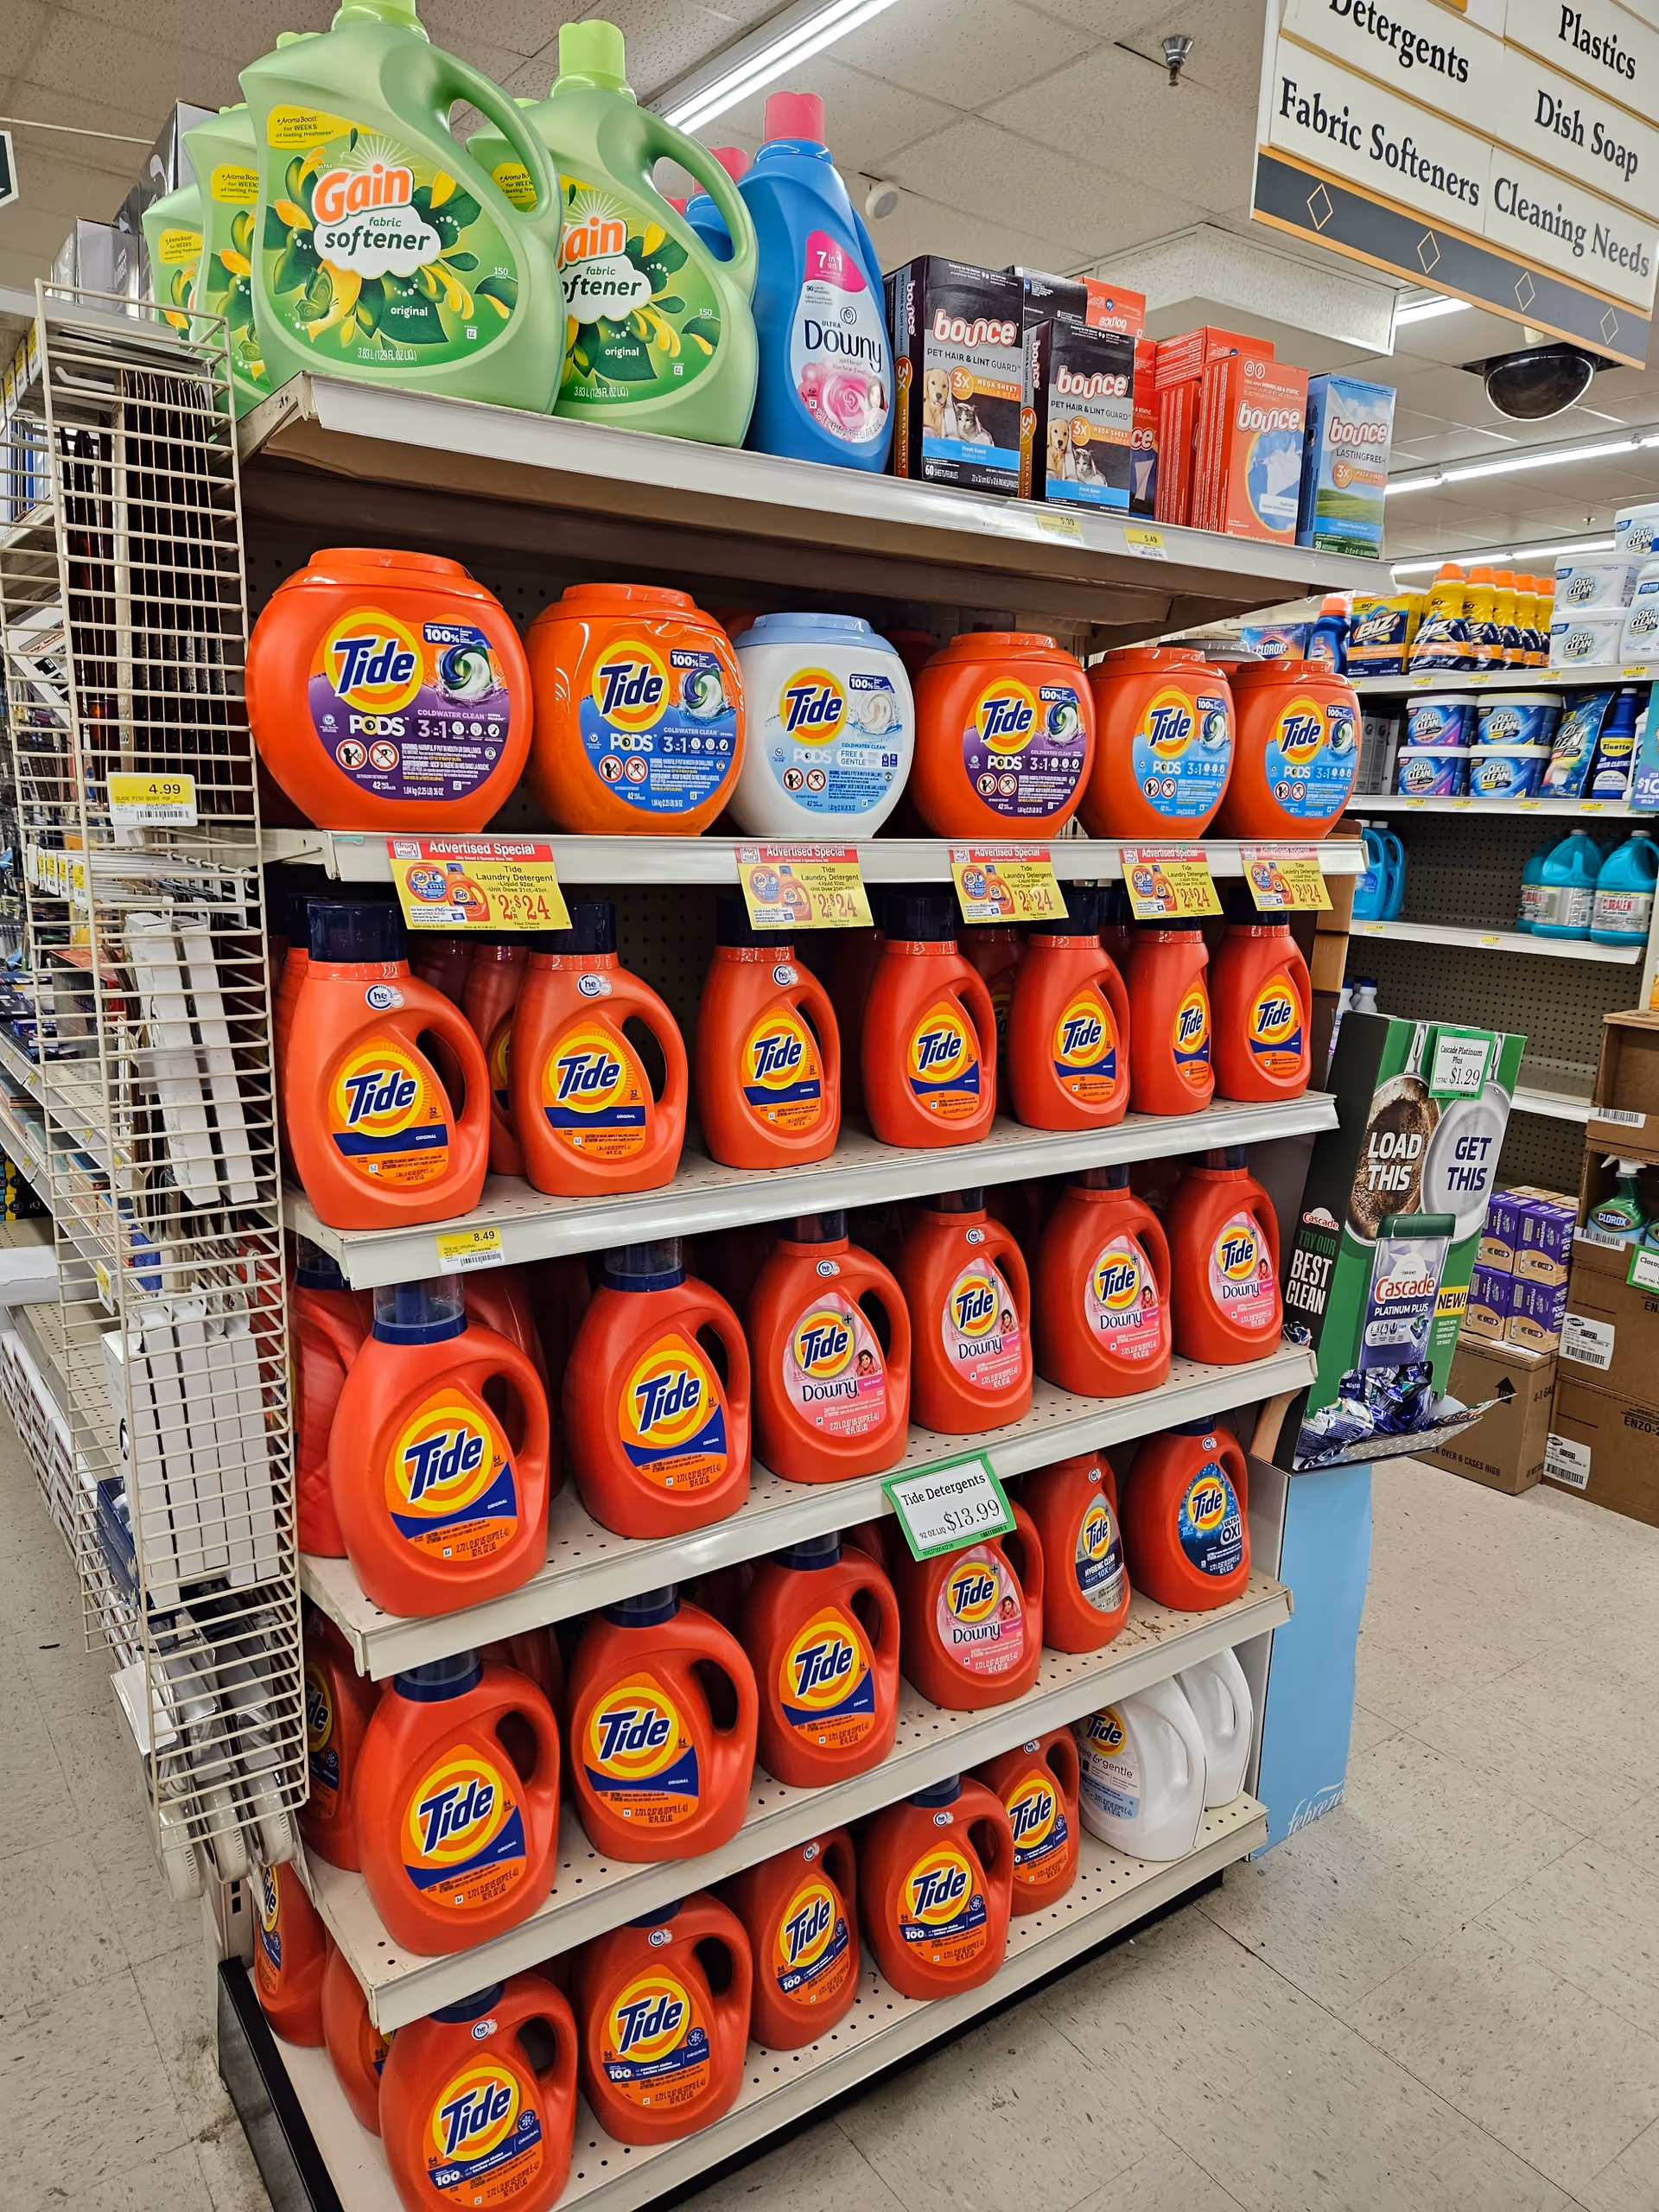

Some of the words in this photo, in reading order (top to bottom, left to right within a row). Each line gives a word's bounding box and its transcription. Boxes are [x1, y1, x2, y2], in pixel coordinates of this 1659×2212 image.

[1558, 4, 1637, 80] Plastics
[1279, 77, 1363, 150] Fabric
[1370, 123, 1480, 207] Softeners
[1535, 90, 1585, 147] Dish
[1591, 125, 1638, 181] Soap
[314, 162, 413, 223] Gain
[368, 217, 402, 228] fabric
[1493, 177, 1587, 257] Cleaning
[1591, 224, 1649, 277] Needs
[324, 227, 431, 256] softener
[557, 217, 623, 269] ain
[587, 266, 615, 275] fabric
[817, 251, 827, 269] 7
[836, 252, 843, 271] 1
[563, 274, 642, 303] oftener
[391, 306, 429, 319] original
[932, 308, 1016, 349] bounce
[605, 346, 639, 358] original
[804, 320, 883, 373] Downy
[927, 348, 943, 358] PET
[944, 350, 964, 360] HAIR
[965, 354, 971, 363] &
[973, 356, 989, 366] LINT
[991, 359, 1017, 372] GUARD
[977, 379, 995, 389] MEGA
[996, 382, 1017, 392] SHEET
[1056, 365, 1128, 400] bounce
[1238, 400, 1300, 434] bounce
[1329, 416, 1388, 446] bounce
[1060, 518, 1075, 526] 5.99
[1567, 585, 1594, 598] CLEAN
[1574, 577, 1591, 588] OXI
[425, 628, 460, 643] 100%
[1357, 613, 1400, 639] BIZ
[332, 636, 416, 696] Tide
[599, 663, 665, 717] Tide
[785, 686, 842, 733] Tide
[981, 698, 1033, 742] Tide
[1497, 712, 1514, 723] OXI
[349, 715, 405, 735] PODS
[1148, 707, 1192, 748] Tide
[1280, 714, 1322, 754] Tide
[1488, 720, 1519, 732] CLEAN
[610, 734, 653, 752] PODS
[793, 747, 833, 764] PODS
[987, 755, 1023, 771] PODS
[1153, 761, 1181, 774] PODS
[1283, 766, 1311, 779] PODS
[149, 785, 181, 794] 4.99
[429, 841, 492, 855] Advertised
[493, 843, 535, 857] Special
[766, 845, 809, 858] Advertised
[811, 846, 845, 858] Special
[373, 992, 388, 1001] he
[1179, 1006, 1204, 1044] Tide
[1255, 999, 1292, 1035] Tide
[917, 1030, 962, 1072] Tide
[1061, 1017, 1103, 1056] Tide
[1440, 1045, 1458, 1054] Cascade
[1459, 1047, 1483, 1057] Platinum
[753, 1033, 802, 1081] Tide
[1452, 1056, 1463, 1065] Plus
[556, 1052, 620, 1101] Tide
[1449, 1065, 1480, 1087] $1.29
[344, 1070, 417, 1125] Tide
[1367, 1132, 1423, 1160] LOAD
[1454, 1136, 1492, 1161] GET
[1367, 1165, 1413, 1192] THIS
[1446, 1167, 1488, 1192] THIS
[1302, 1211, 1339, 1230] Cascade
[1599, 1213, 1627, 1227] CLOROX
[474, 1230, 494, 1242] 8.49
[1300, 1229, 1315, 1249] TRY
[1316, 1234, 1337, 1255] OUR
[1222, 1239, 1253, 1274] Tide
[1290, 1249, 1332, 1288] BEST
[1099, 1265, 1135, 1302] Tide
[1223, 1281, 1260, 1299] Downy
[1285, 1279, 1326, 1315] CLEAN
[1375, 1276, 1434, 1305] Cascade
[956, 1294, 994, 1331] Tide
[1374, 1305, 1410, 1317] PLATINUM
[1411, 1303, 1428, 1313] PLUS
[1437, 1293, 1466, 1310] NEW!
[1100, 1307, 1142, 1330] Downy
[800, 1325, 849, 1371] Tide
[958, 1337, 1003, 1359] Downy
[633, 1370, 701, 1434] Tide
[802, 1379, 859, 1402] Downy
[404, 1427, 483, 1504] Tide
[1441, 1448, 1457, 1461] OVER
[1465, 1456, 1484, 1471] CASES
[1485, 1465, 1500, 1477] HIGH
[487, 1499, 508, 1510] ORIGINAL
[900, 1492, 925, 1506] Tide
[925, 1474, 986, 1500] Detergents
[937, 1527, 947, 1535] LIQ
[944, 1499, 1000, 1535] $13.99
[1191, 1490, 1224, 1527] Tide
[1221, 1516, 1240, 1529] ULTRA
[1086, 1517, 1108, 1556] Tide
[1220, 1526, 1242, 1545] OXI
[1084, 1559, 1104, 1577] HYGIENIC
[1104, 1553, 1116, 1566] CLEAN
[1098, 1567, 1109, 1579] 10X
[951, 1580, 995, 1615] Tide
[952, 1620, 1001, 1643] Downy
[793, 1639, 854, 1698] Tide
[596, 1709, 671, 1762] Tide
[1086, 1713, 1123, 1745] Tide
[1093, 1754, 1103, 1764] &
[1103, 1759, 1133, 1778] gentle
[418, 1778, 494, 1856] Tide
[1009, 1791, 1052, 1844] Tide
[497, 1840, 518, 1853] ORIGINAL
[912, 1861, 967, 1920] Tide
[785, 1897, 830, 1968] Tide
[614, 1993, 685, 2056] Tide
[439, 2082, 512, 2161] Tide
